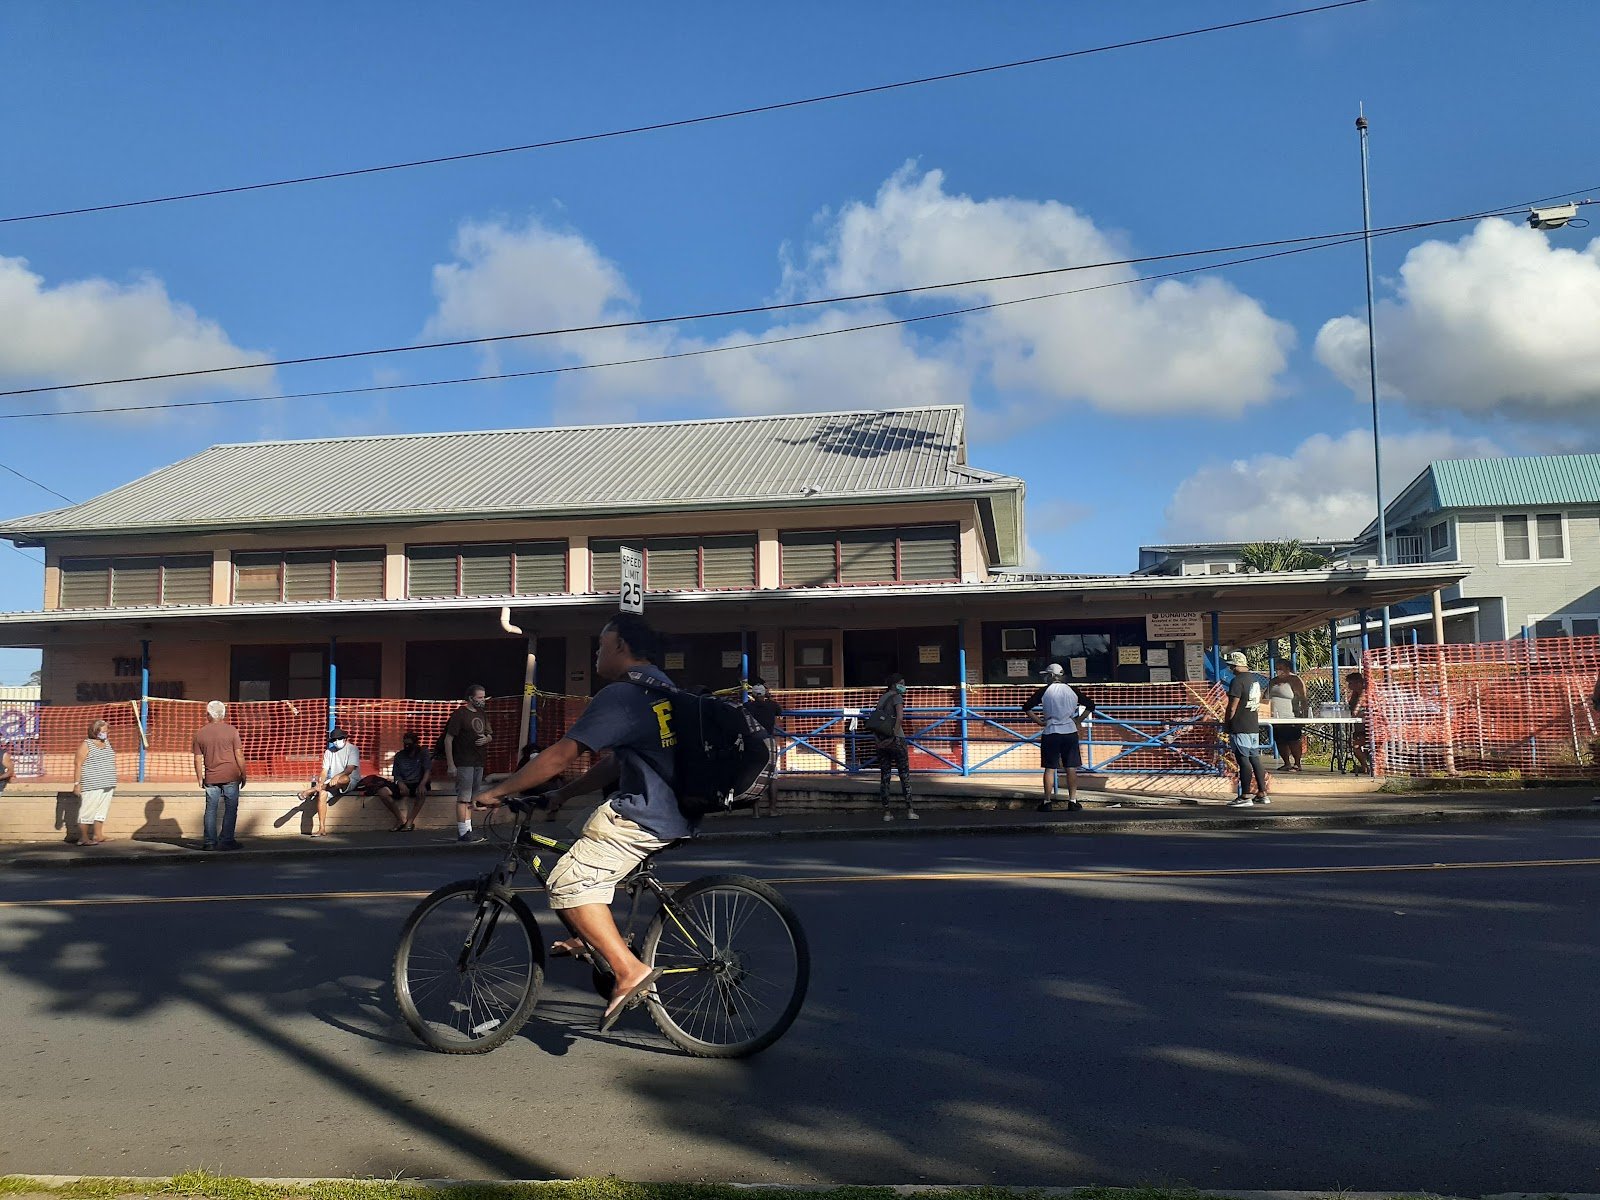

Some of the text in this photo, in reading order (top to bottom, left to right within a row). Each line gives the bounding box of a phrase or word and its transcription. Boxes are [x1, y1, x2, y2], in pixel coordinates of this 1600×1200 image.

[622, 555, 642, 568] SPEED
[624, 568, 640, 580] LIMIT
[623, 581, 641, 605] 25
